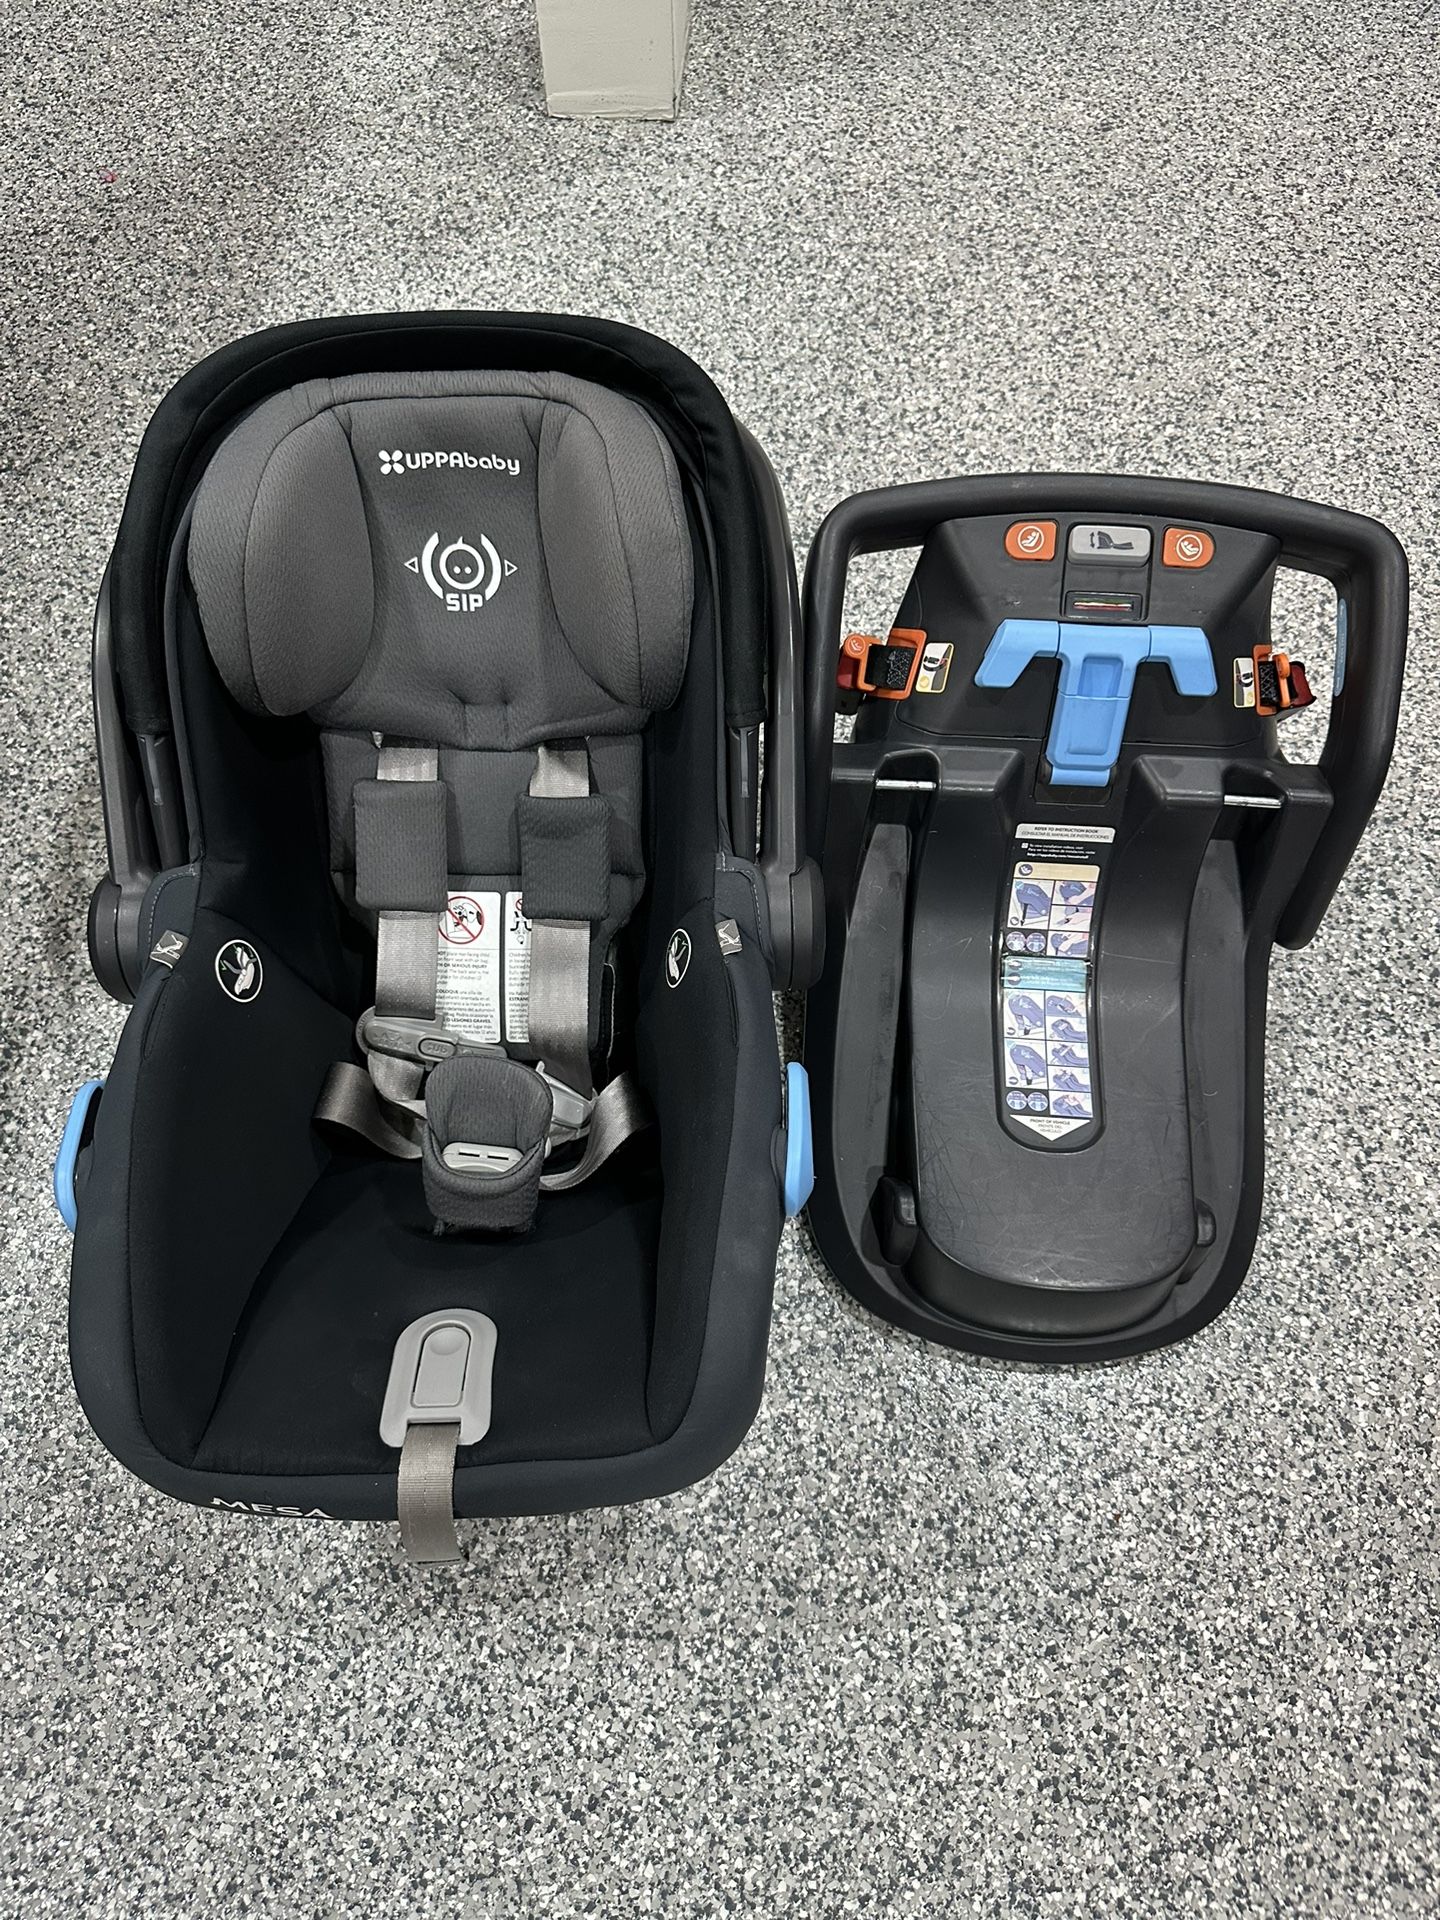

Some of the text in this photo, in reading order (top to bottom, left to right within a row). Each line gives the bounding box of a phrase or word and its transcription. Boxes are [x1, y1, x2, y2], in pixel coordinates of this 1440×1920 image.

[405, 451, 521, 476] UPPAbaby
[445, 593, 483, 612] SIP
[210, 1497, 335, 1519] MESA
